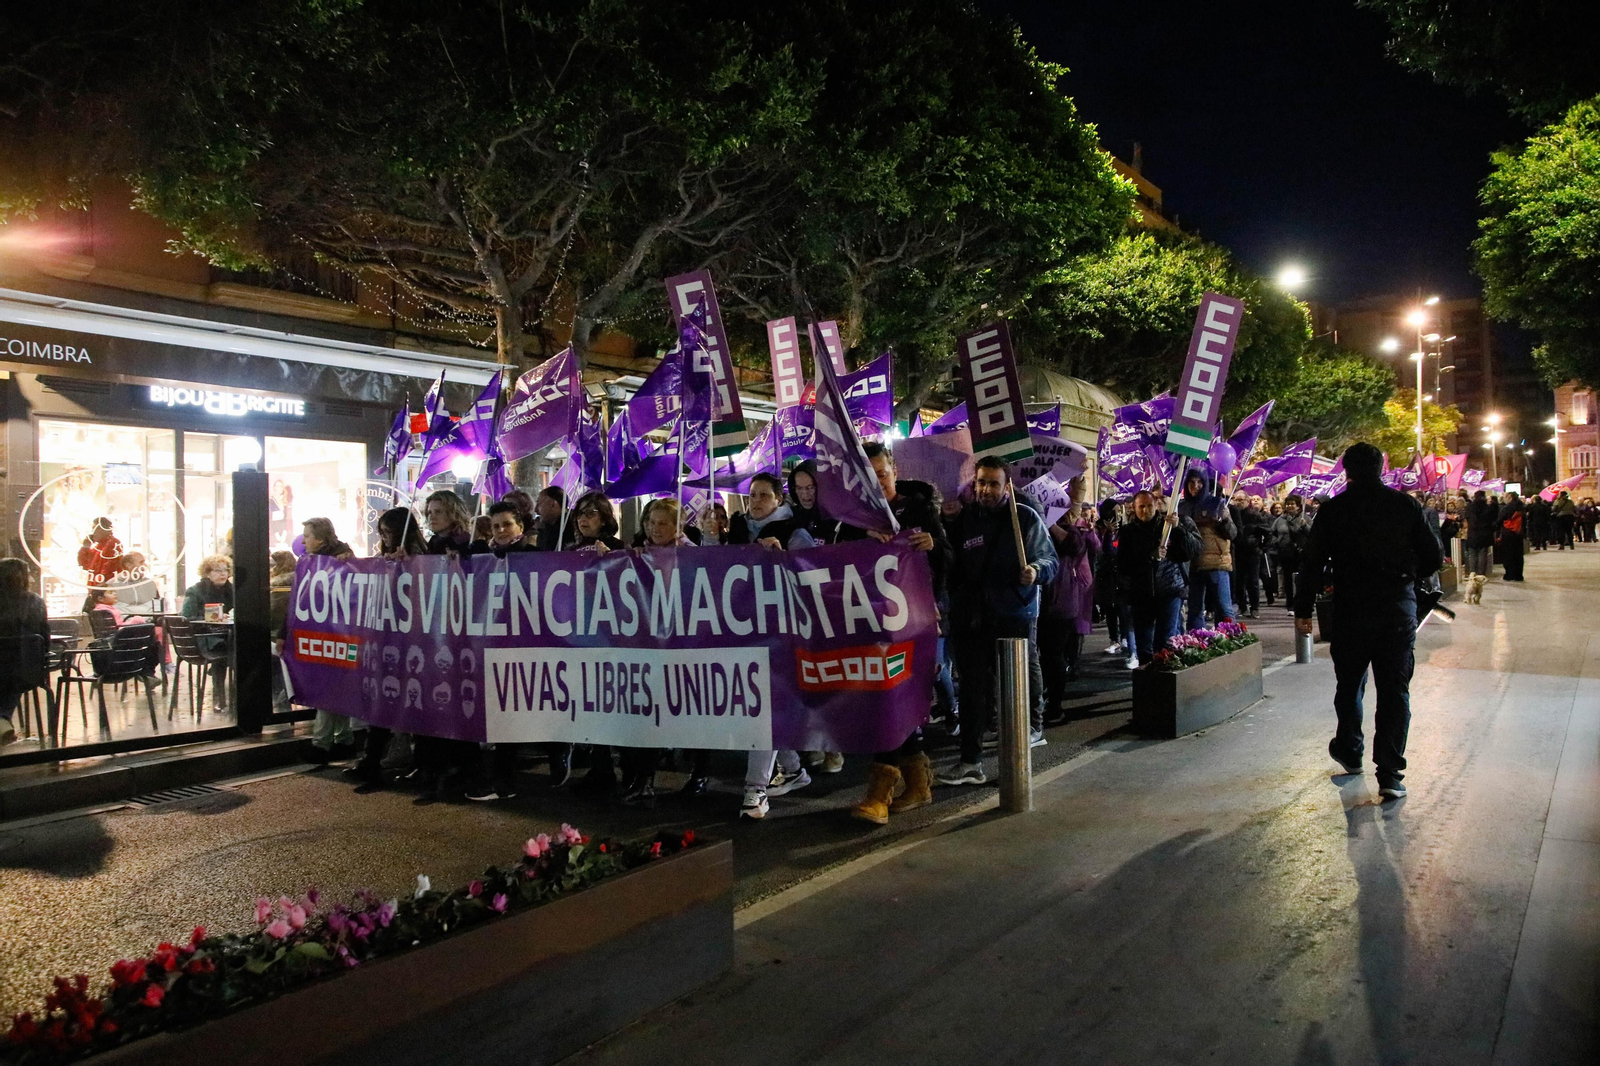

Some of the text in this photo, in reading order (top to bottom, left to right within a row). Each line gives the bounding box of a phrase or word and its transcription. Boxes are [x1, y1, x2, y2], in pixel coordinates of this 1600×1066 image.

[773, 325, 800, 404] CCO
[967, 329, 1015, 434] CCOO
[1182, 301, 1235, 422] CCOO
[150, 385, 204, 406] BIJOU
[1033, 444, 1072, 456] MUJER
[112, 565, 147, 584] 1969
[418, 568, 639, 637] VIOLENCIAS
[650, 554, 909, 640] MACHISTAS
[298, 637, 348, 659] CCOO
[801, 655, 885, 684] CCOO
[493, 660, 761, 727] VIVAS, LIBRES, UNIDAS
